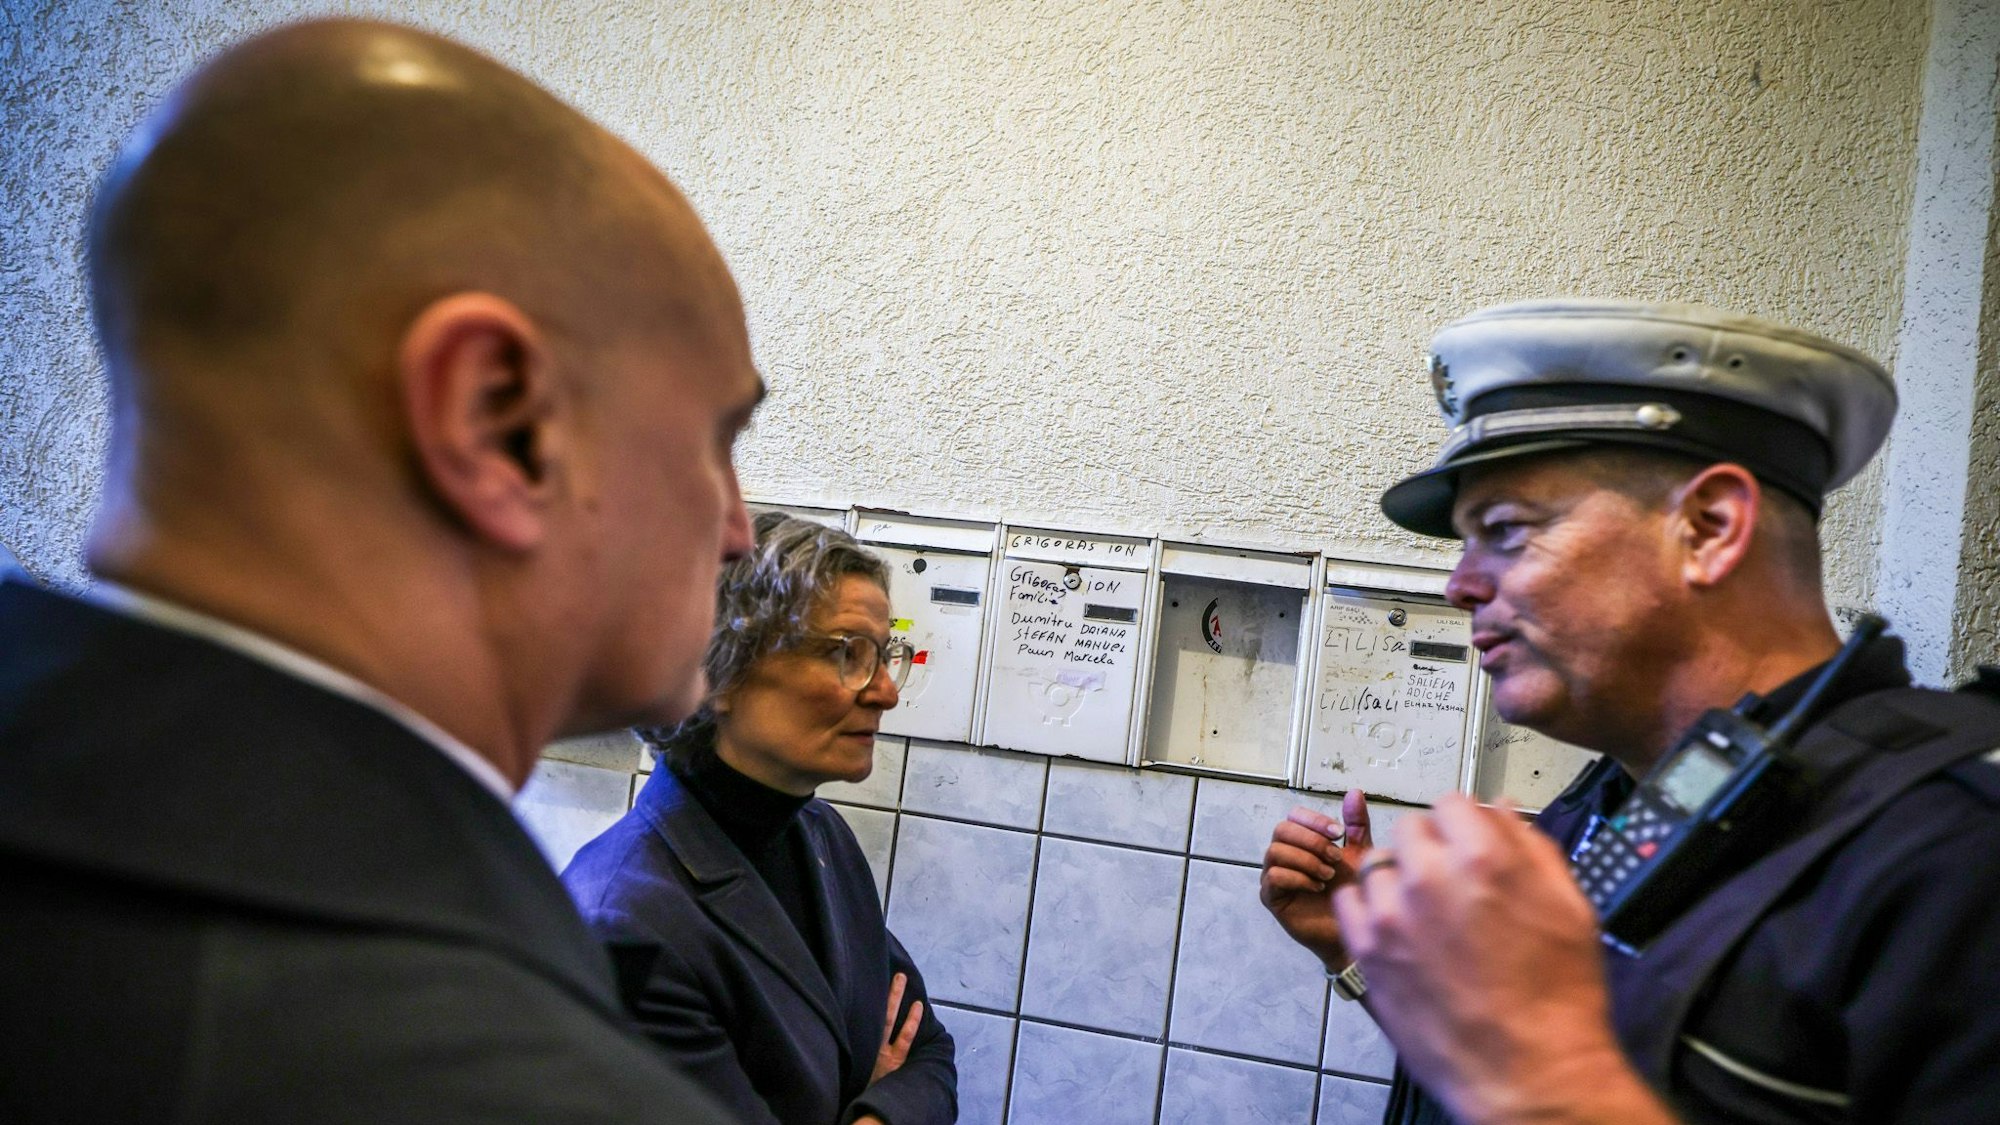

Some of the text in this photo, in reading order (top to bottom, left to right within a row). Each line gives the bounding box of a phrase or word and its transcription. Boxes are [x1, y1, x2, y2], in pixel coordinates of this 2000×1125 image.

[1011, 535, 1095, 551] GRIGORAS
[1011, 611, 1073, 629] Dumitru
[1063, 650, 1115, 665] Marcela
